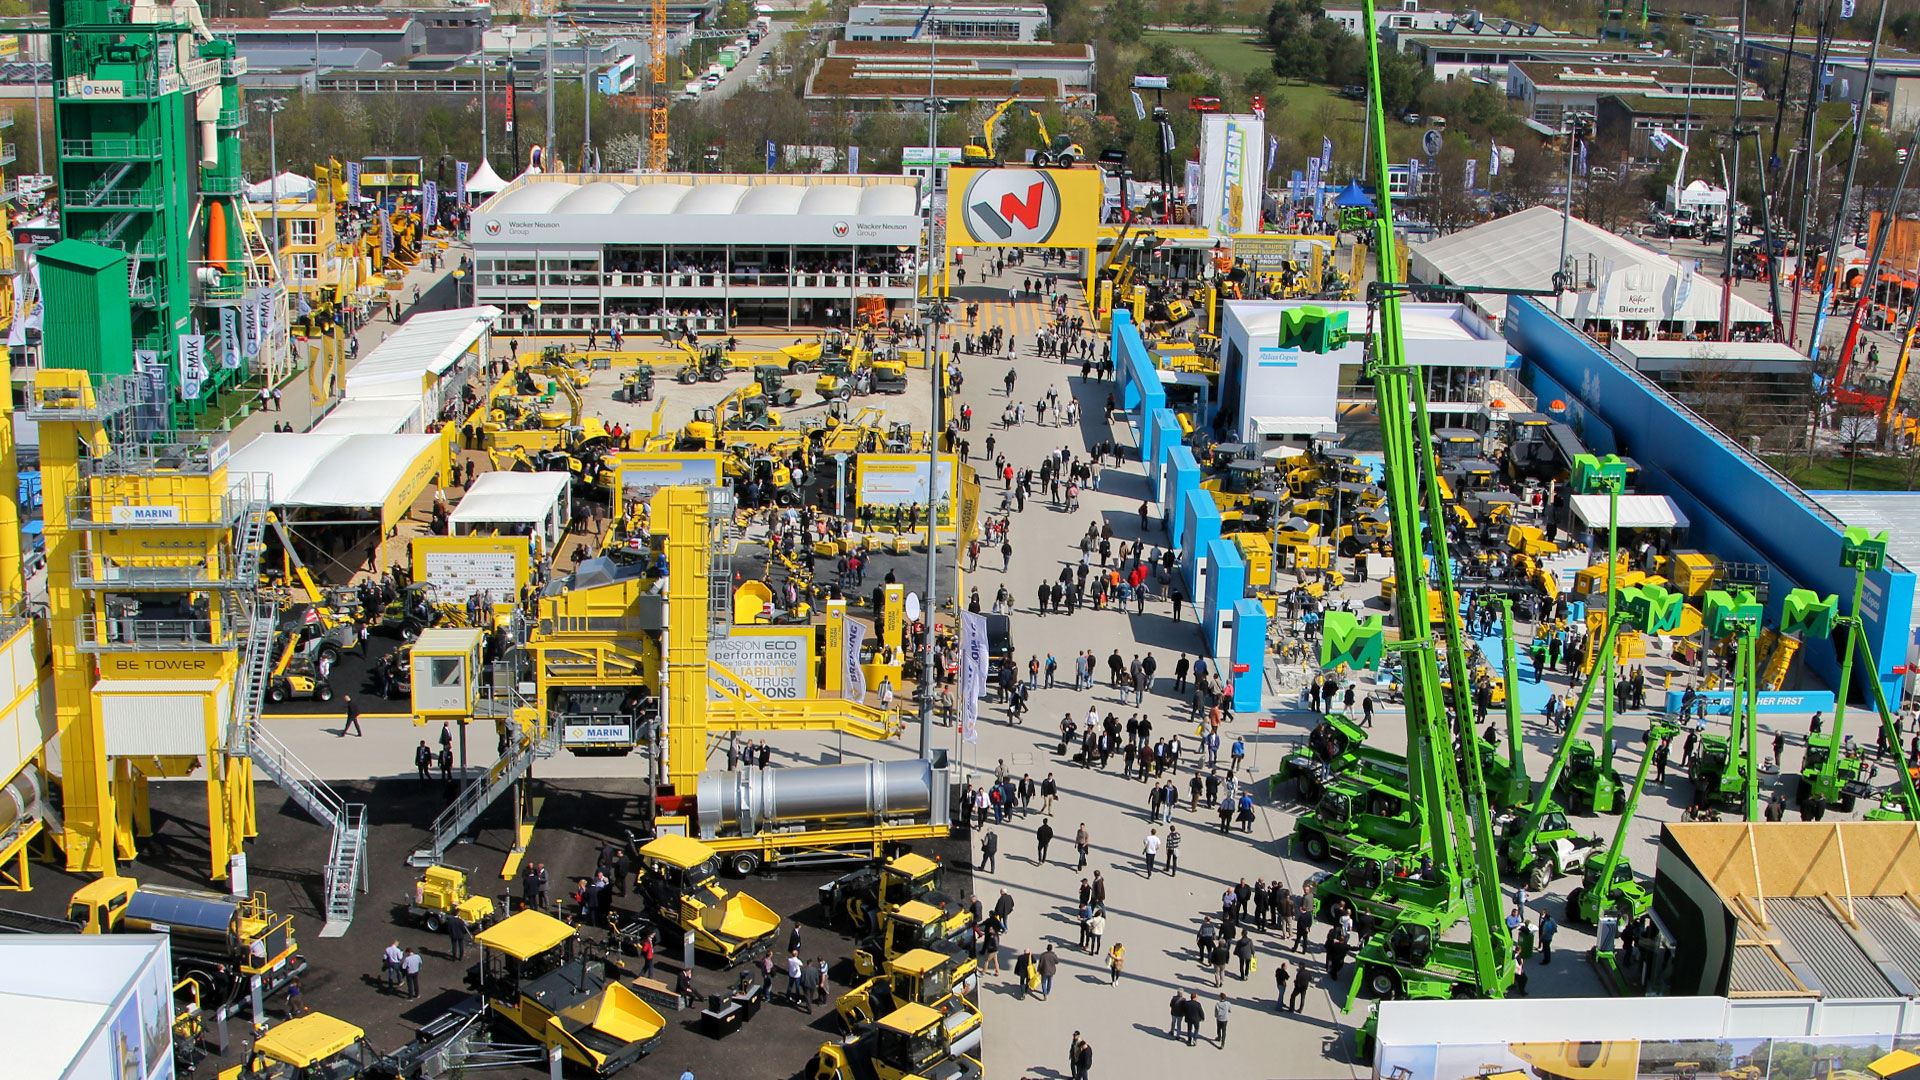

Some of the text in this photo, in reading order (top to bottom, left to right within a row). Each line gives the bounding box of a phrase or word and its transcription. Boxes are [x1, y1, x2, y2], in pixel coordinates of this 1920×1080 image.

[94, 86, 121, 94] E-MAK
[1629, 295, 1647, 304] Käfer
[1619, 305, 1655, 313] Bierzelt
[247, 303, 255, 346] E-MAK
[225, 314, 234, 351] E-MAK
[187, 340, 198, 380] E-MAK
[1258, 353, 1278, 361] Atlas
[217, 445, 229, 460] MARINI
[135, 509, 173, 518] MARINI
[714, 641, 797, 650] PASSION ECO
[715, 650, 796, 661] performance
[116, 660, 206, 670] BE TOWER
[755, 677, 796, 687] TRUST
[1777, 697, 1804, 705] FIRST
[587, 728, 623, 737] MARINI
